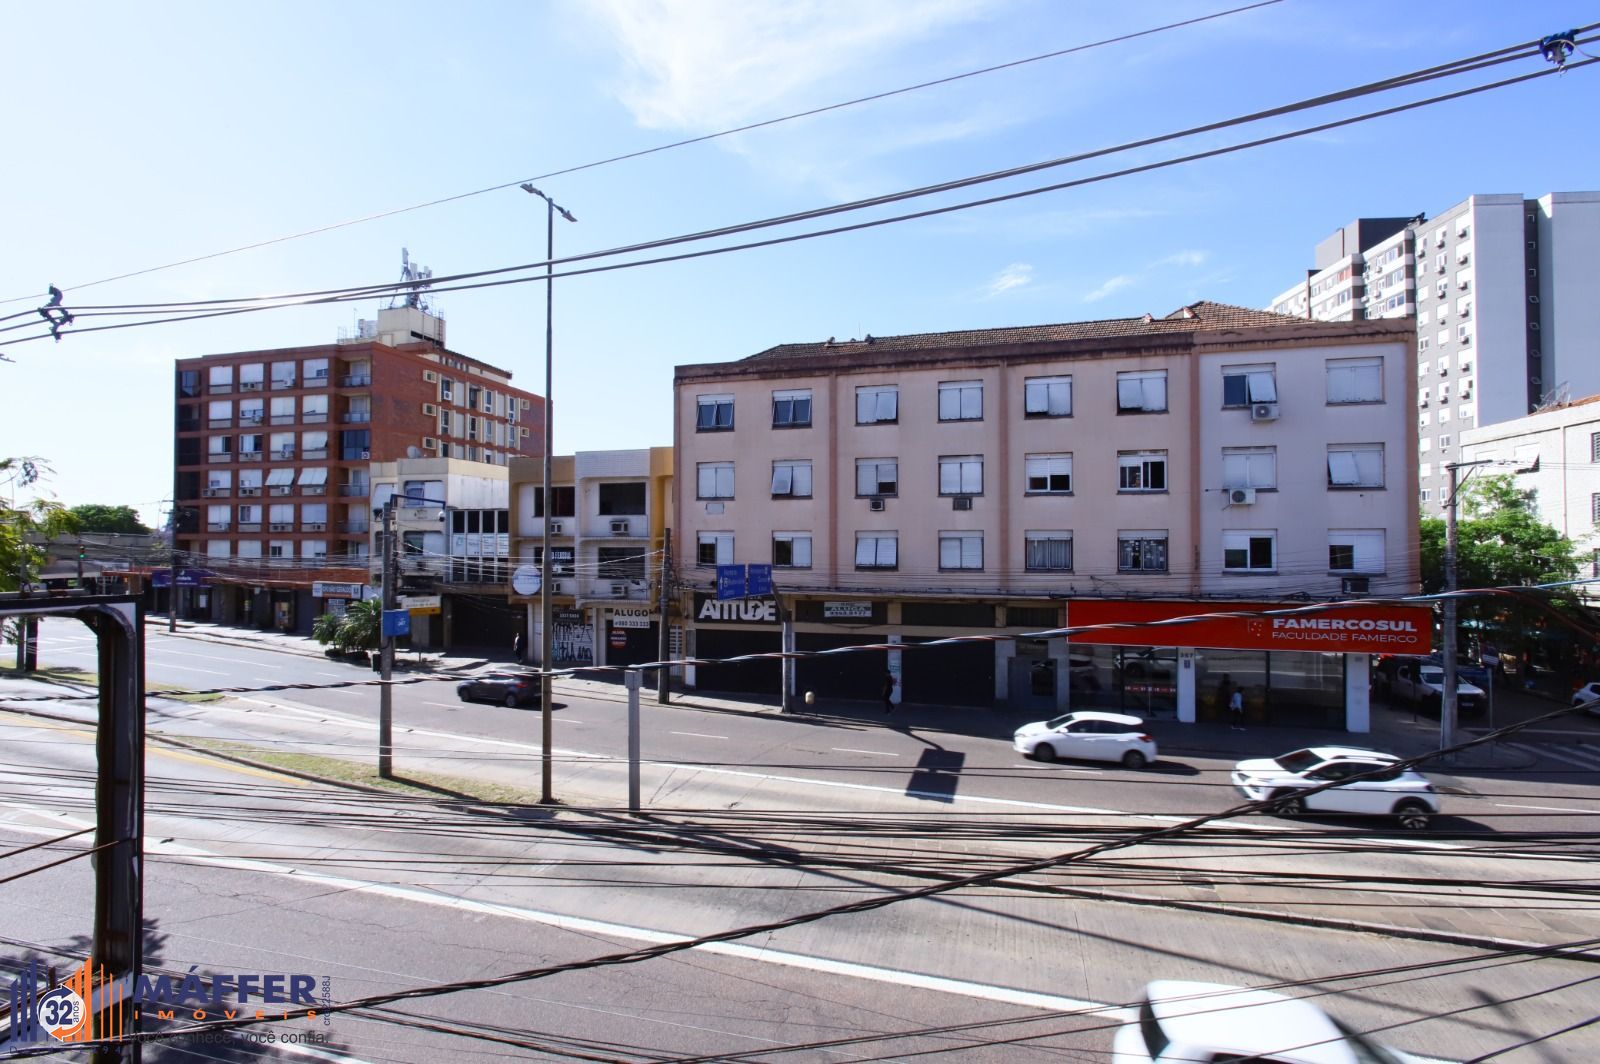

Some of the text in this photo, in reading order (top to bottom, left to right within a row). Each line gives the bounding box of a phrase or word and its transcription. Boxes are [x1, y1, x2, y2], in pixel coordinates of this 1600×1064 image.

[614, 609, 649, 617] ALUGO
[698, 599, 777, 621] ATITUDE
[1272, 618, 1418, 632] FAMERCOSUL
[1272, 631, 1418, 644] FACULDADE FAMERCO
